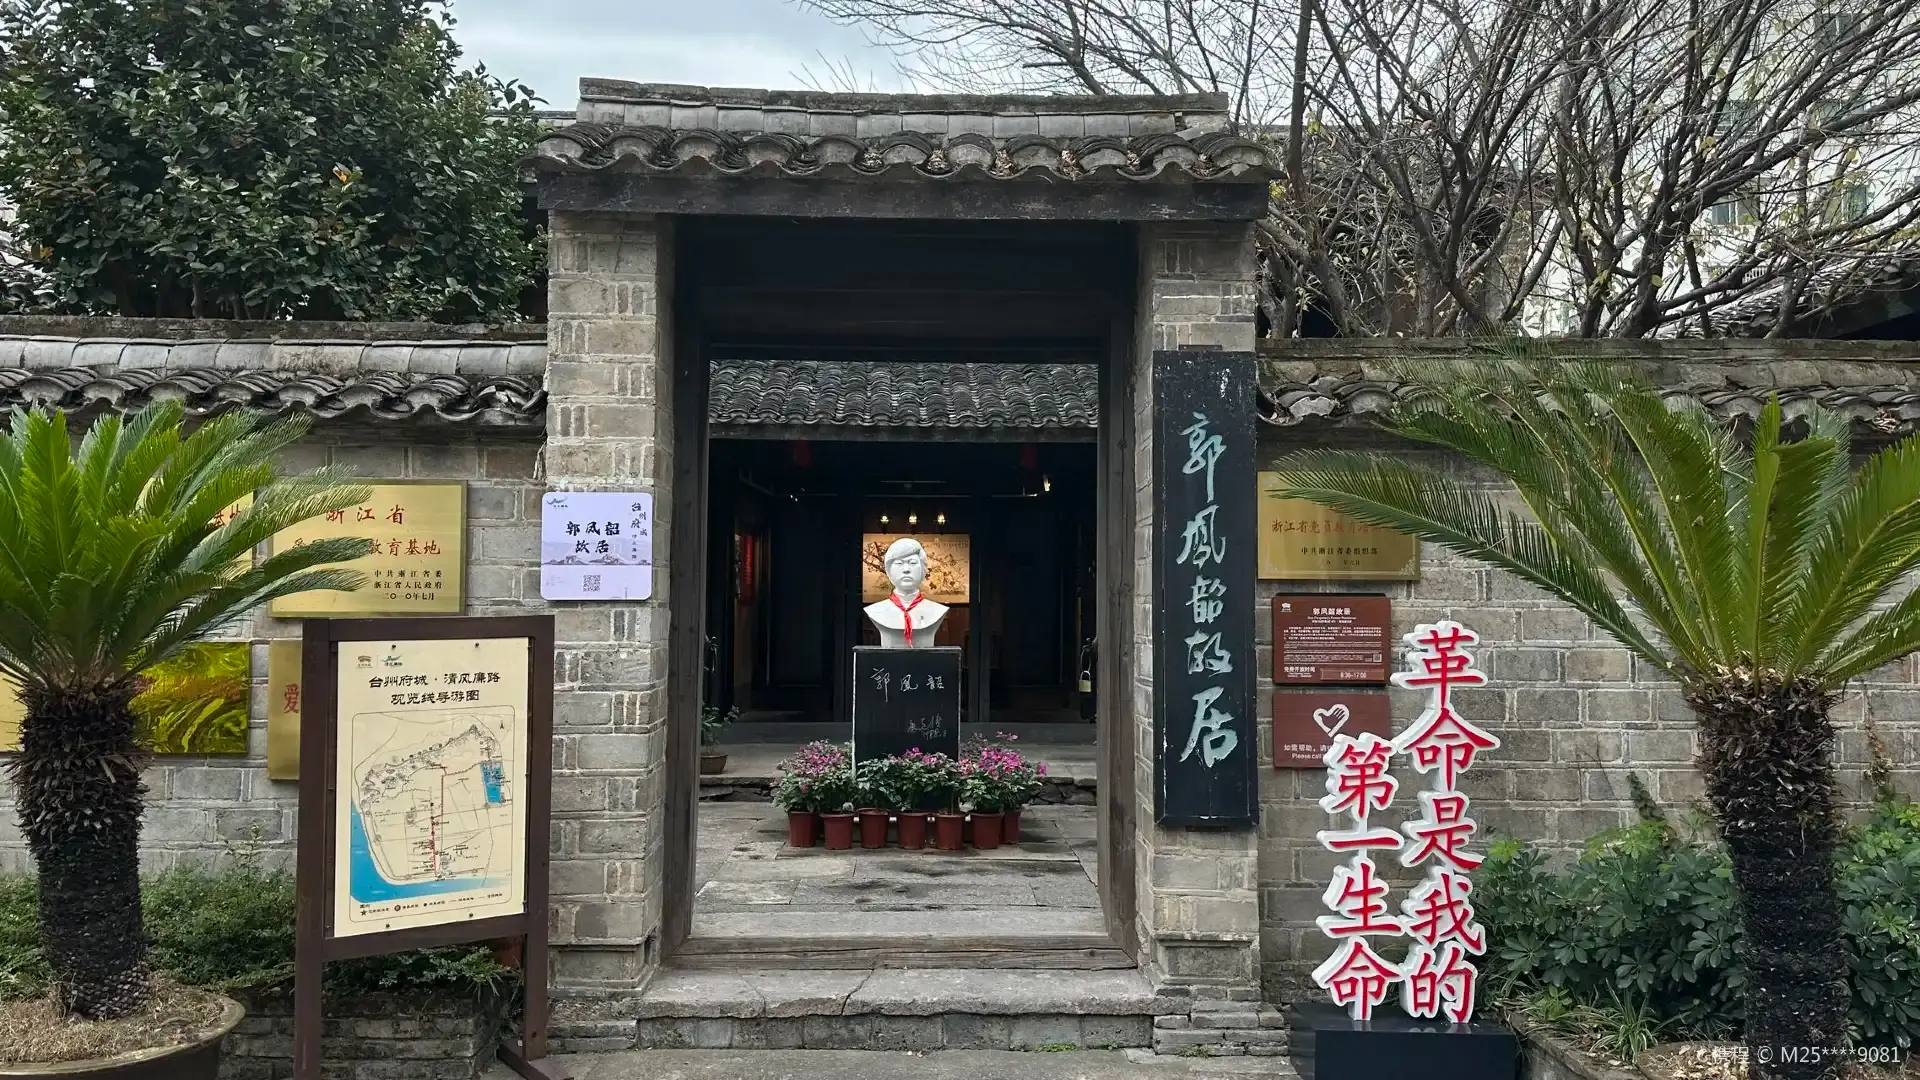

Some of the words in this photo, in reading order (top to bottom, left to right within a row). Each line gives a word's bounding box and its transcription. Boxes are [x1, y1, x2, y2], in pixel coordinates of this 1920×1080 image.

[326, 504, 404, 525] 浙江省
[565, 521, 620, 536] 郭凤韶
[575, 540, 609, 553] 故居
[374, 569, 442, 578] 中共浙江省委
[373, 581, 442, 589] 浙江省人民政府
[1404, 627, 1496, 1022] 革命是我的
[1326, 742, 1402, 1019] 第一生命
